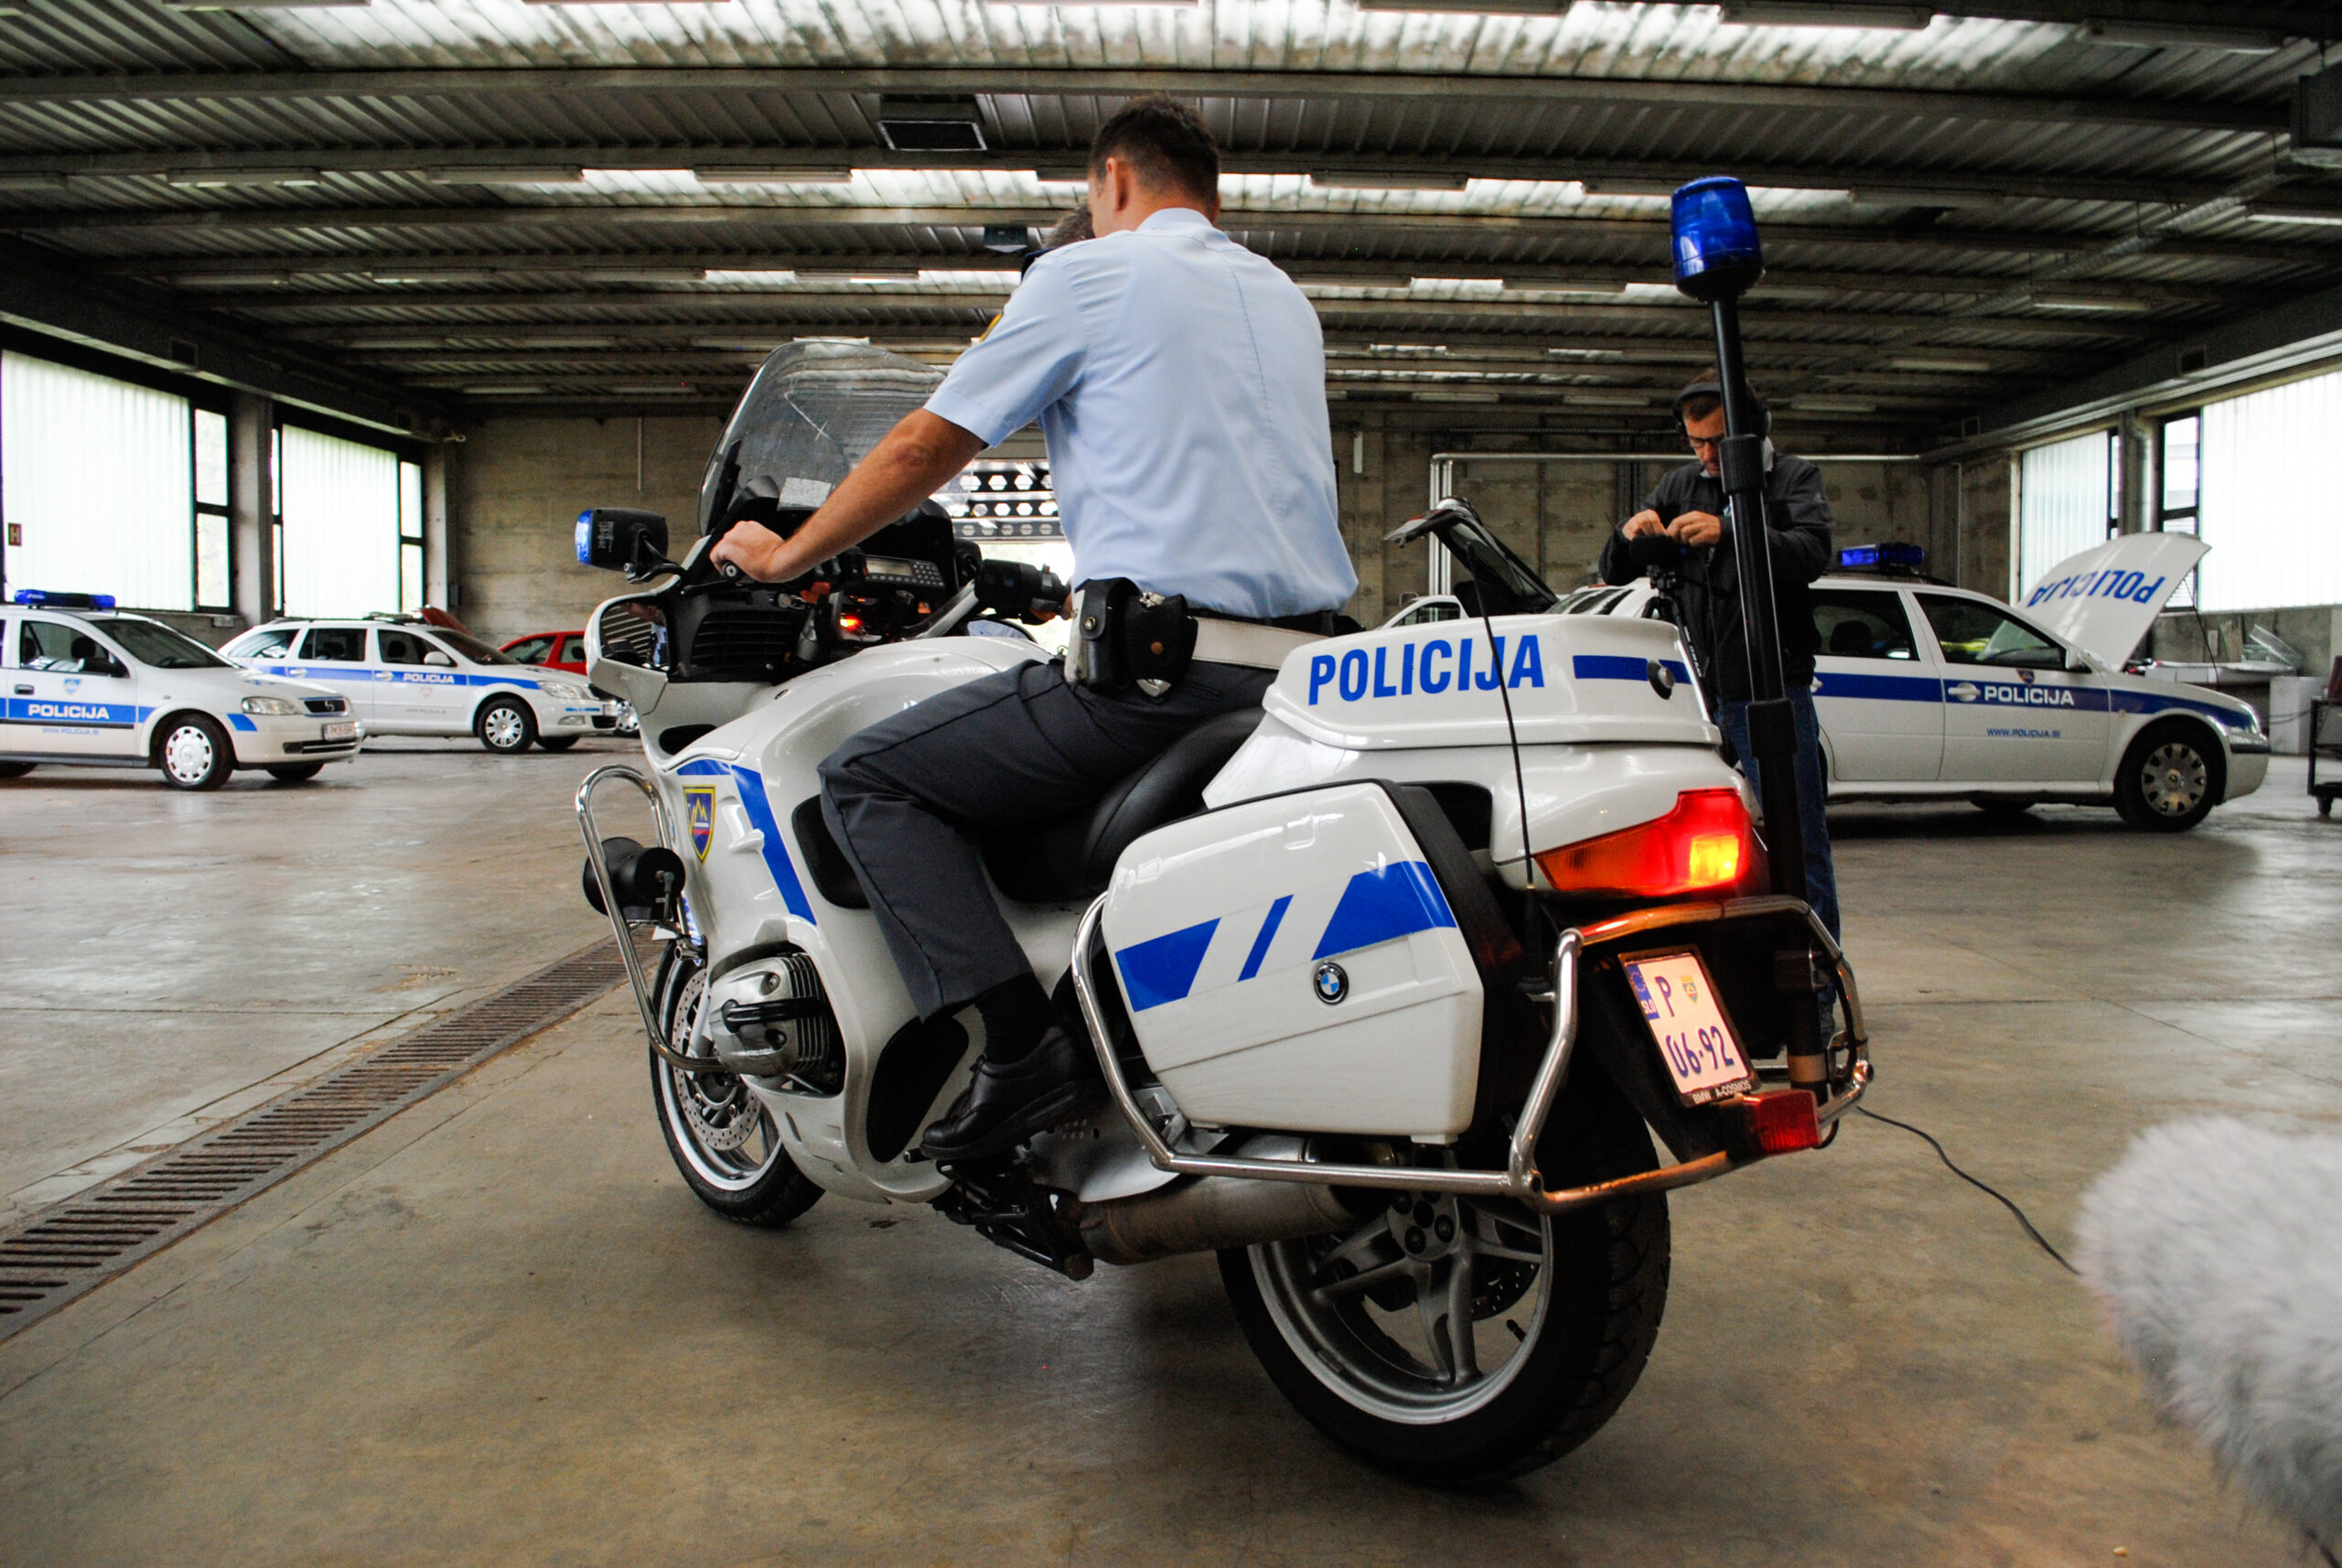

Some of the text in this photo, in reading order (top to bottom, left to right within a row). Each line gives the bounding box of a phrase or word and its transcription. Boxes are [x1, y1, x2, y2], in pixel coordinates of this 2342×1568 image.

[2025, 569, 2166, 607] POLICIJA
[403, 672, 455, 684] POLICIJA
[1308, 634, 1546, 706] POLICIJA
[1984, 685, 2075, 705] POLICIJA
[27, 703, 110, 720] POLICIJA
[1640, 999, 1658, 1014] SLO
[1654, 975, 1675, 1017] P
[1692, 1079, 1752, 1105] BMW A-COSMOS
